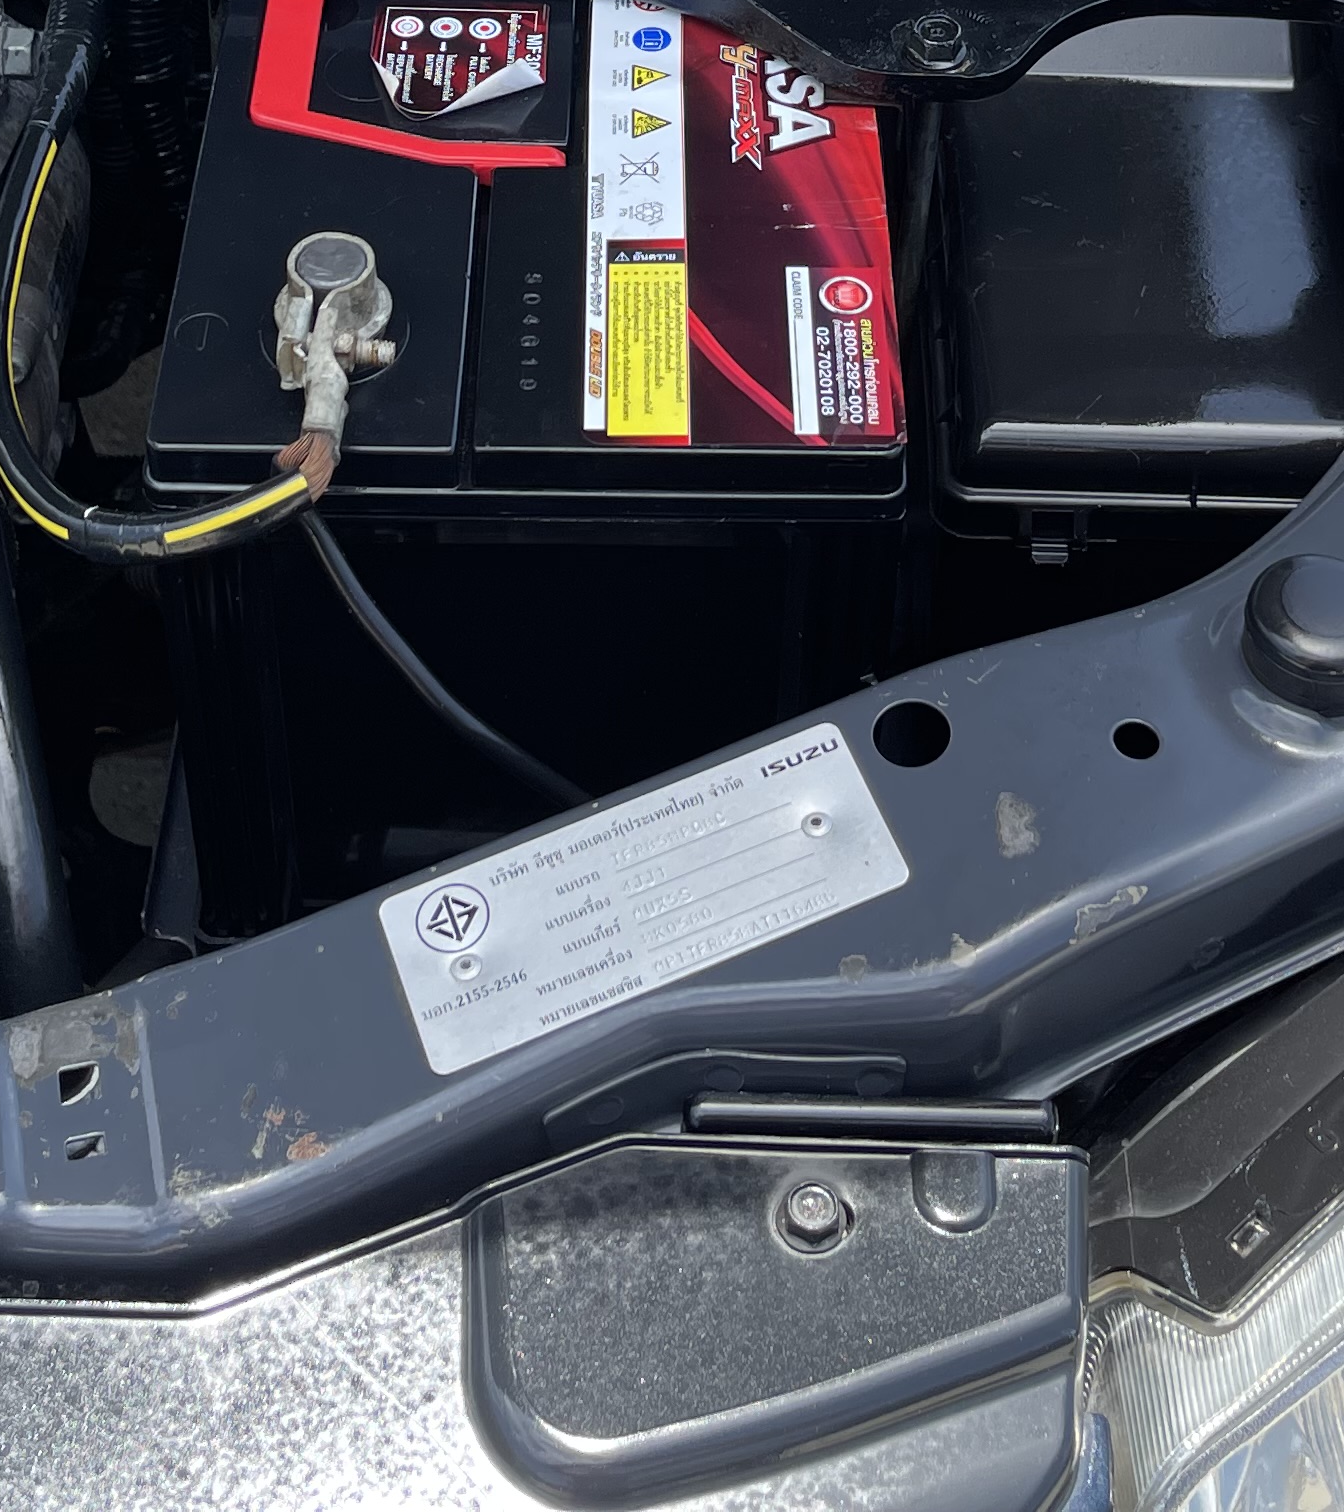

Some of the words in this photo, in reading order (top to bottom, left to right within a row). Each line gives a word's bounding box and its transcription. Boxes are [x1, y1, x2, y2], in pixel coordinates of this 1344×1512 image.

[424, 54, 434, 80] BATTERY
[433, 54, 444, 86] RECHARGE
[469, 56, 478, 71] FULL
[525, 34, 543, 76] MF30
[632, 251, 676, 263] อันตราย
[791, 272, 801, 295] CLAIM
[793, 297, 803, 320] CODE
[589, 328, 604, 375] DOUBLE
[816, 327, 834, 415] 02-7020108
[843, 320, 863, 424] 1800-292-000
[759, 737, 839, 778] ISUZU
[487, 856, 531, 889] บริษัท
[532, 847, 564, 874] อีซูซุ
[567, 789, 705, 865] มอเตอร์(ประเทศไทย)
[707, 774, 746, 802] จำกัด
[544, 892, 613, 933] แบบเครื่อง
[622, 865, 669, 896] 4JJ1
[554, 867, 602, 899] แบบรถ
[561, 919, 623, 956] แบบเกียร์
[535, 946, 634, 998] หมายเลขเครื่อง
[421, 968, 530, 1022] มอก.2155-2546
[538, 973, 644, 1028] หมายเลขแชสซิส
